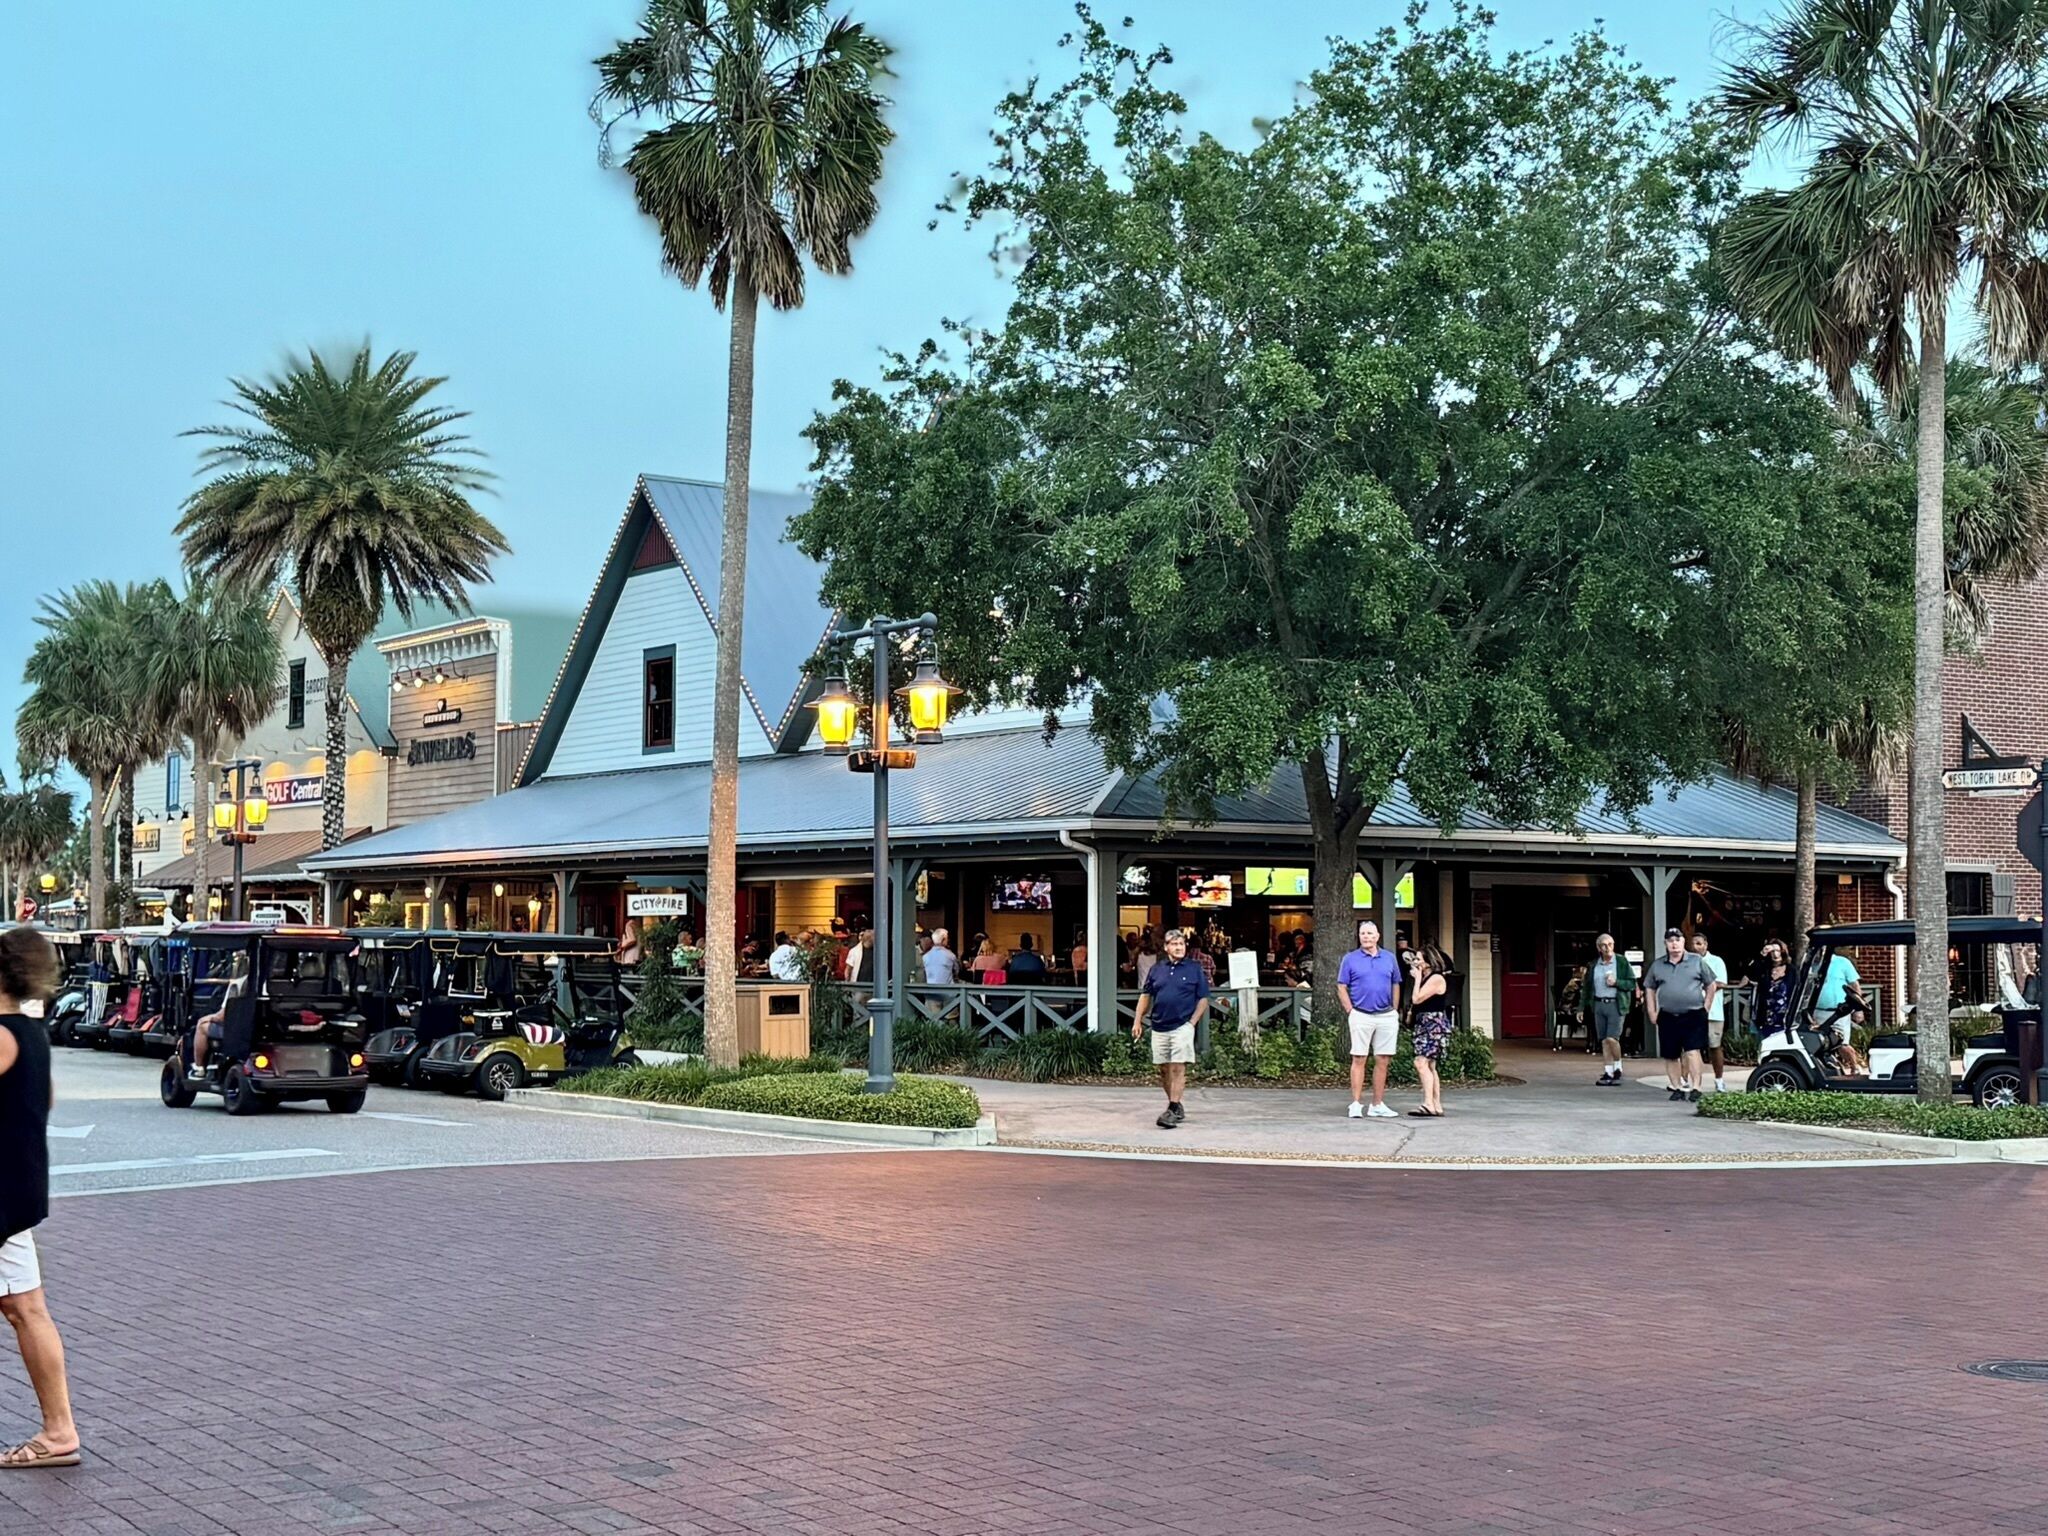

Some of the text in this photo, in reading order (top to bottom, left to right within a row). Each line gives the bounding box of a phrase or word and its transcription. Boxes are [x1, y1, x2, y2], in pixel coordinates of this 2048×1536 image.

[408, 731, 476, 766] JEWELERS
[1970, 771, 1994, 785] TORCH
[1998, 771, 2017, 784] LAKE
[267, 778, 323, 803] GOLF Central
[632, 898, 683, 910] CITY FIRE
